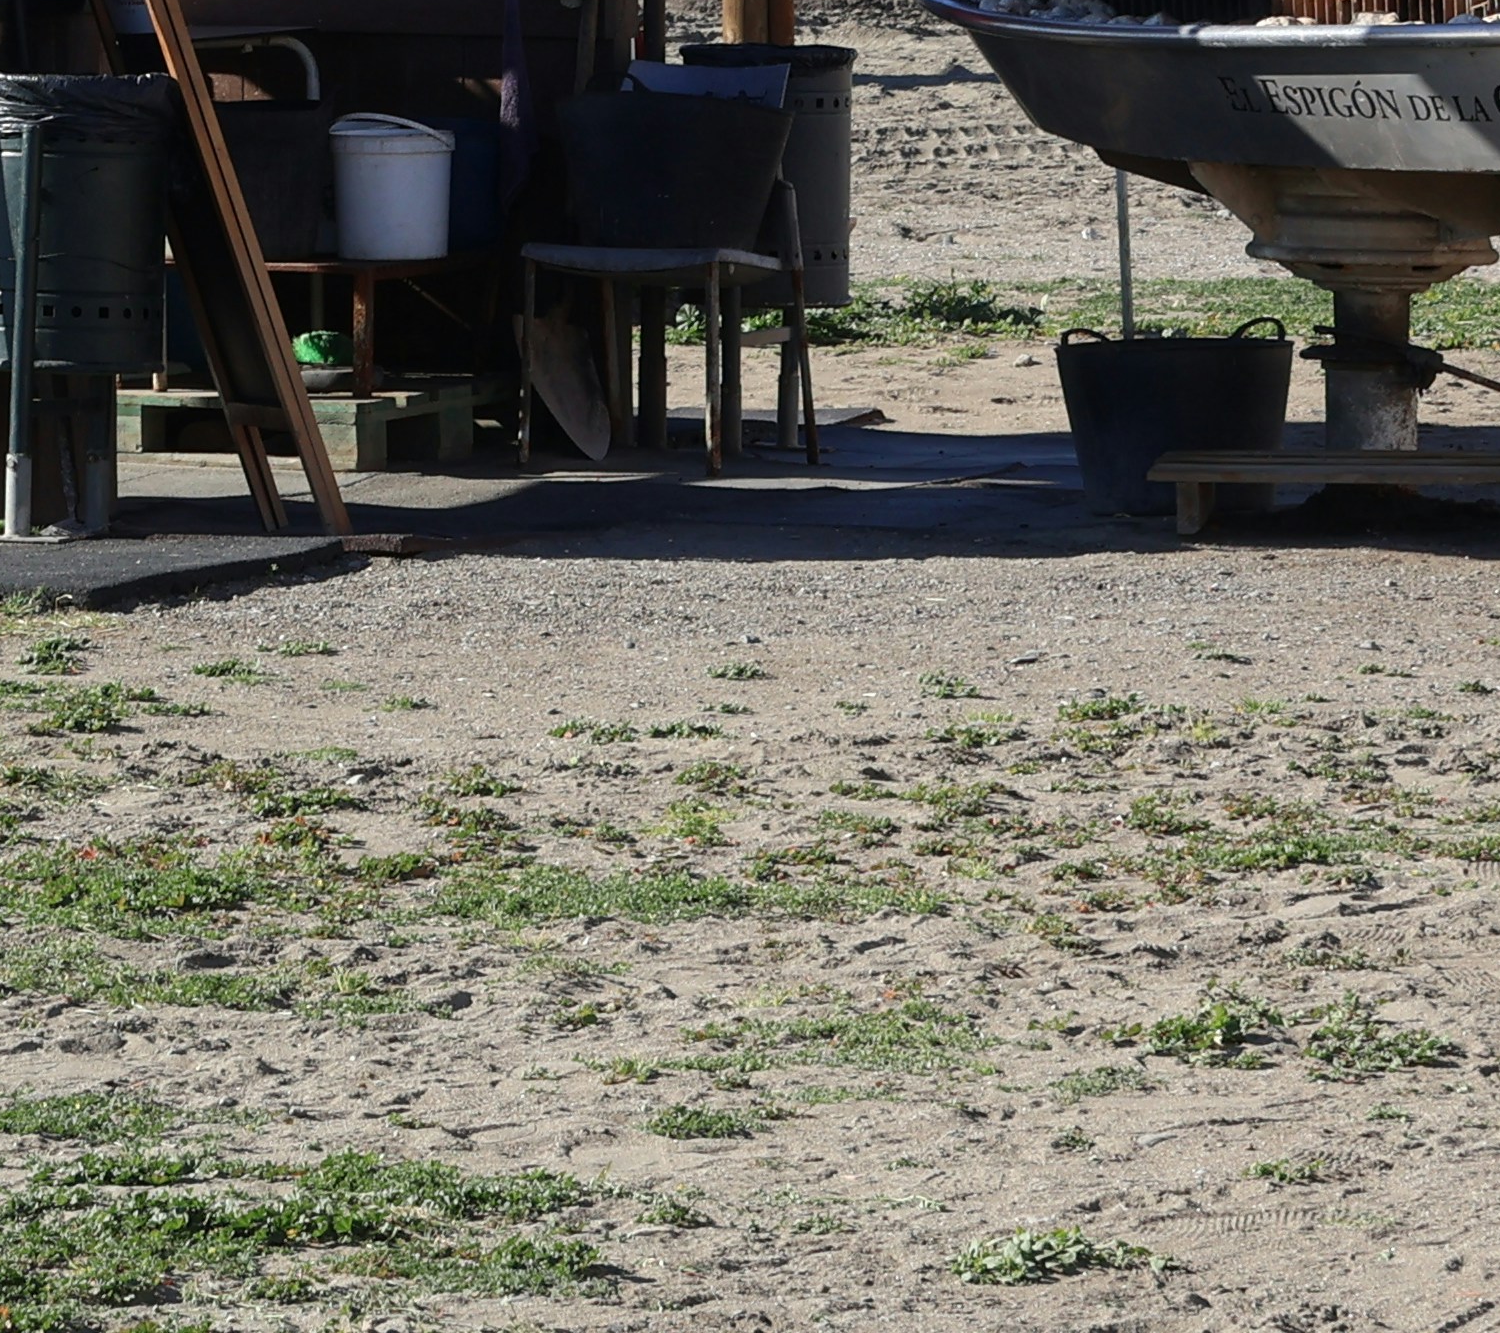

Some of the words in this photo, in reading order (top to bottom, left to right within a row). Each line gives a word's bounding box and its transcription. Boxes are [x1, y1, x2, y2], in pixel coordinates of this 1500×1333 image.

[1259, 79, 1402, 122] ESPIGÓN
[1407, 94, 1451, 122] DE
[1452, 95, 1494, 123] LA
